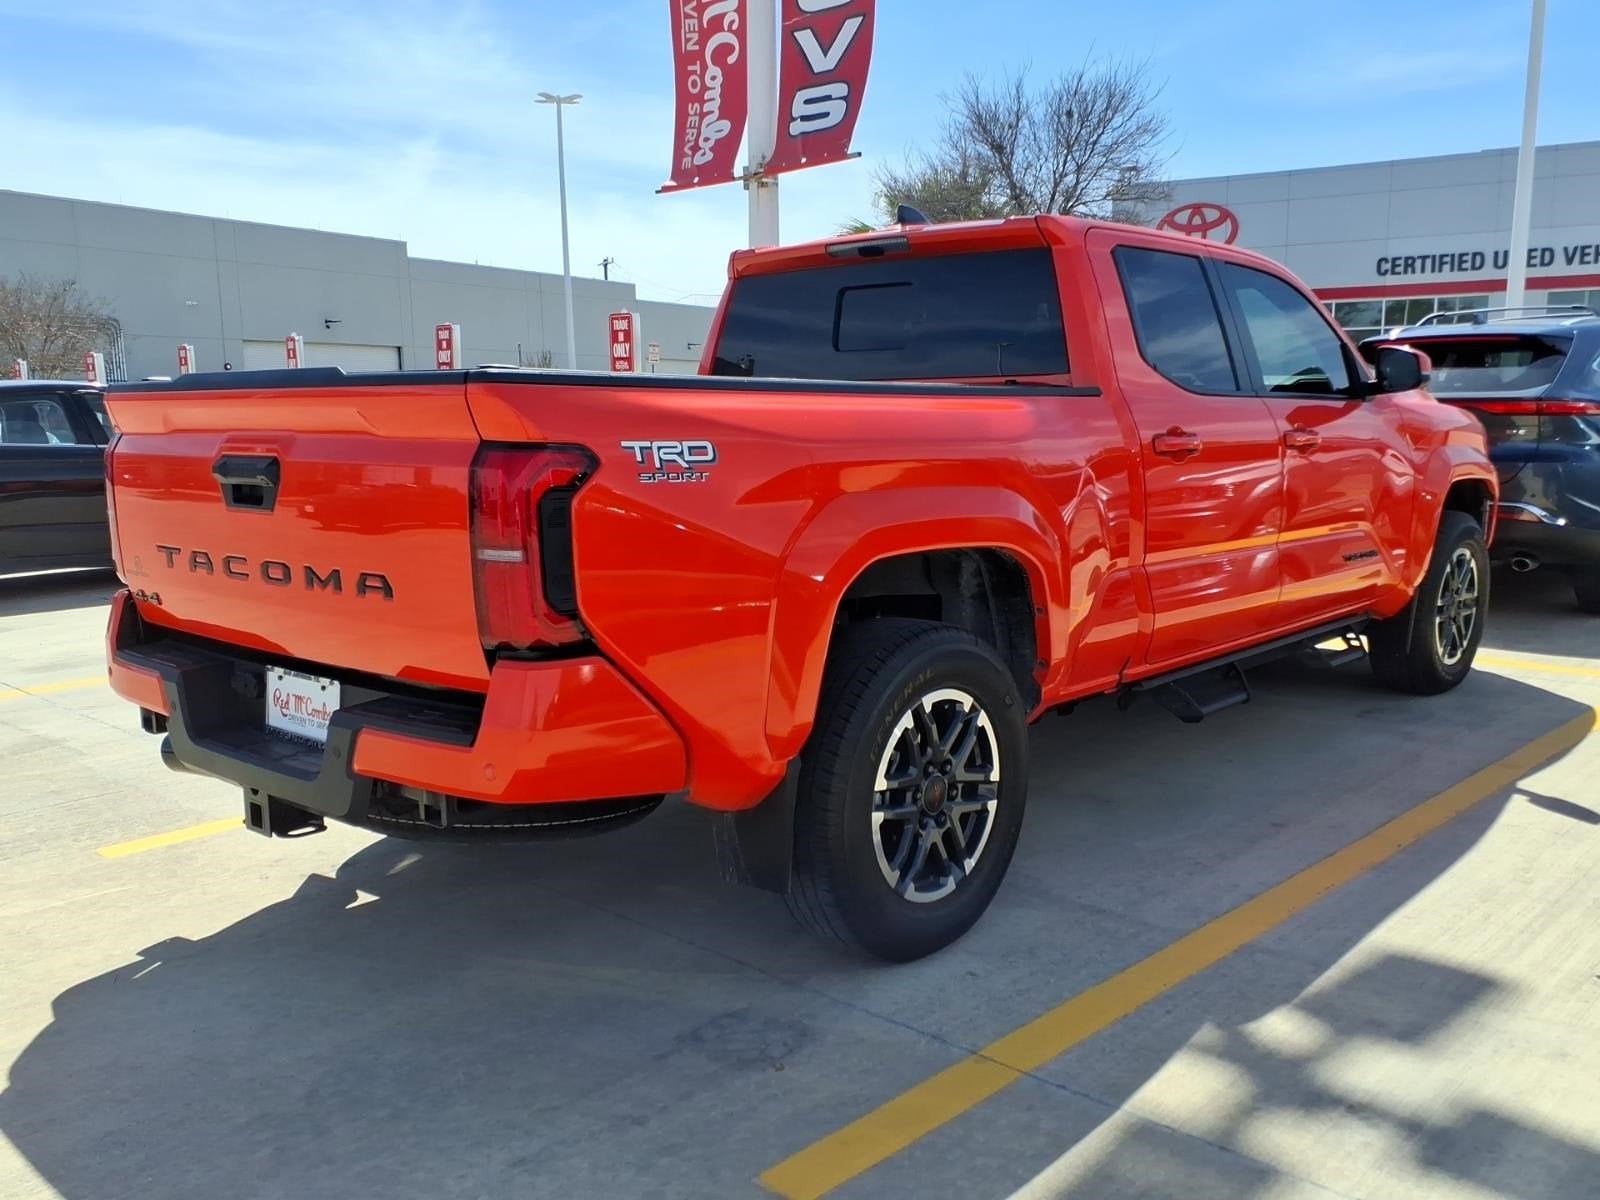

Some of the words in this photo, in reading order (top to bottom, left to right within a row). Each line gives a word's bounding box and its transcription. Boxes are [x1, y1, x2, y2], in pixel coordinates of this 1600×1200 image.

[687, 61, 701, 94] TO
[789, 0, 866, 137] VS
[682, 102, 700, 170] SERVE
[1376, 251, 1485, 276] CERTIFIED
[1493, 247, 1555, 270] UED
[613, 319, 629, 331] TRADE
[613, 343, 630, 358] ONLY
[620, 440, 715, 469] TRD
[639, 472, 710, 483] SPORT
[155, 544, 394, 600] TACOMA
[273, 688, 291, 717] Red
[288, 713, 307, 727] DRIVEN
[308, 718, 316, 728] TO
